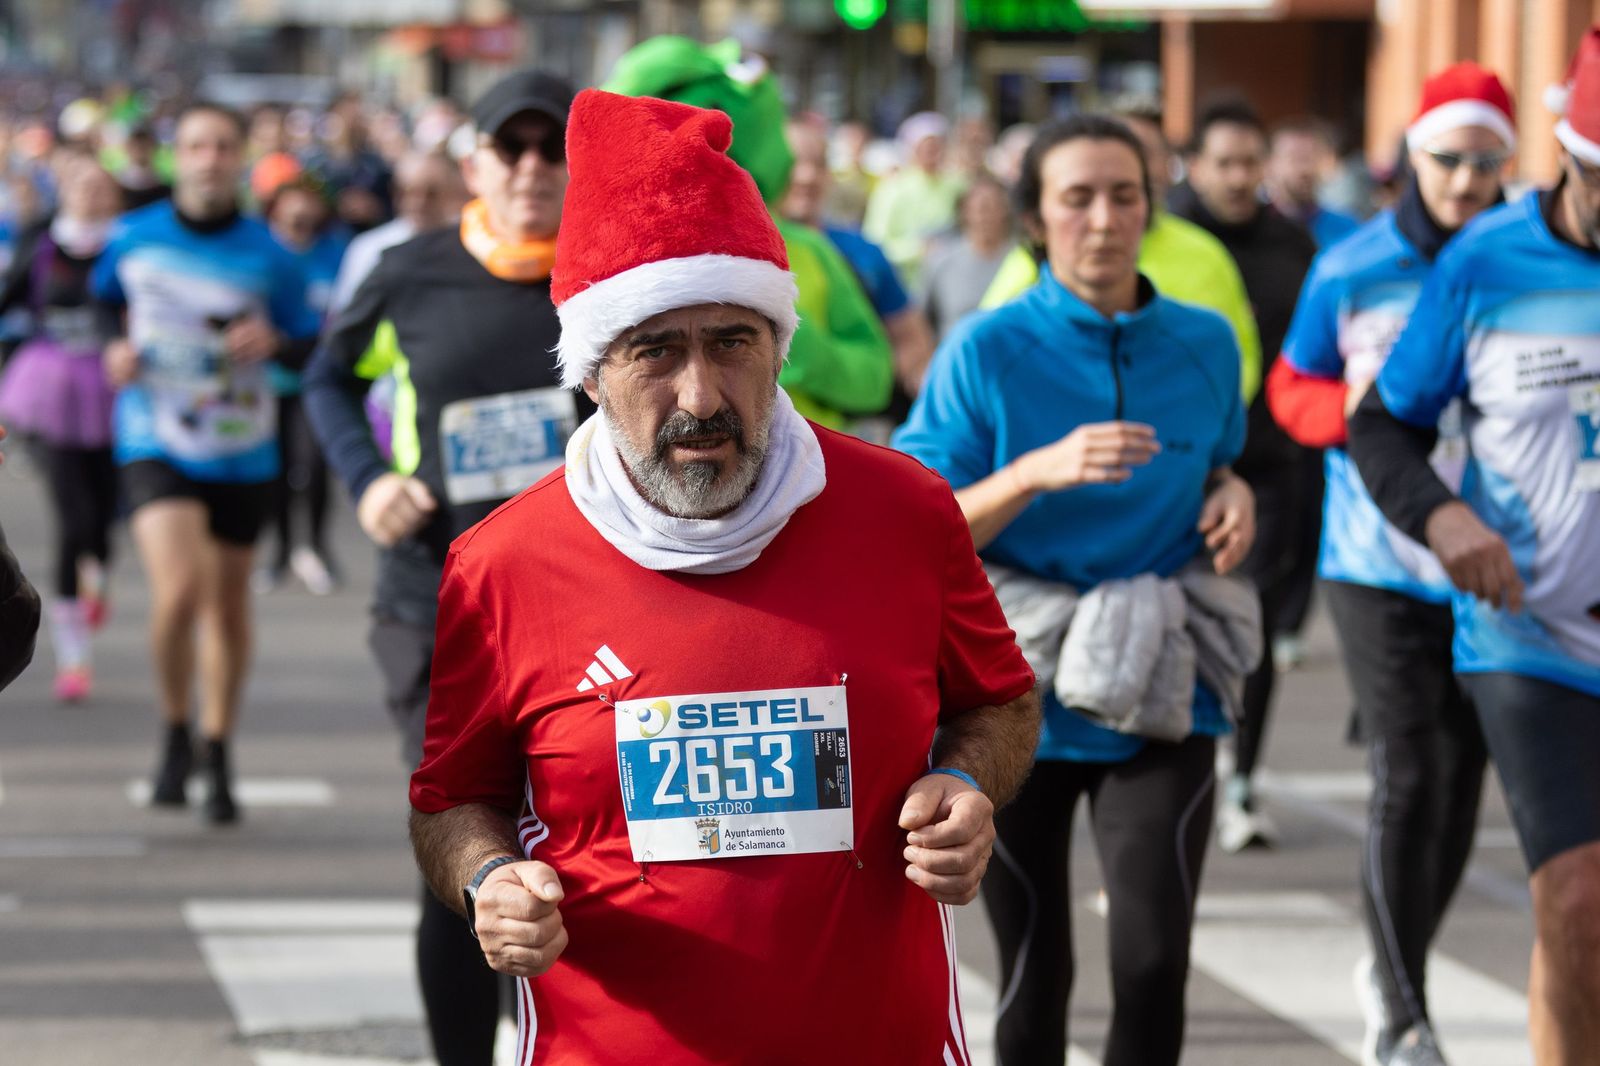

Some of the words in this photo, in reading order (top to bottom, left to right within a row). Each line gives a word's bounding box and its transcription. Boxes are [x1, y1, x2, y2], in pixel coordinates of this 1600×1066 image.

[677, 697, 825, 730] SETEL
[838, 736, 846, 758] 2653
[649, 734, 795, 806] 2653
[697, 801, 753, 816] ISIDRO
[724, 827, 785, 839] Ayuntamiento
[725, 841, 737, 851] de
[738, 840, 786, 850] Salamanca
